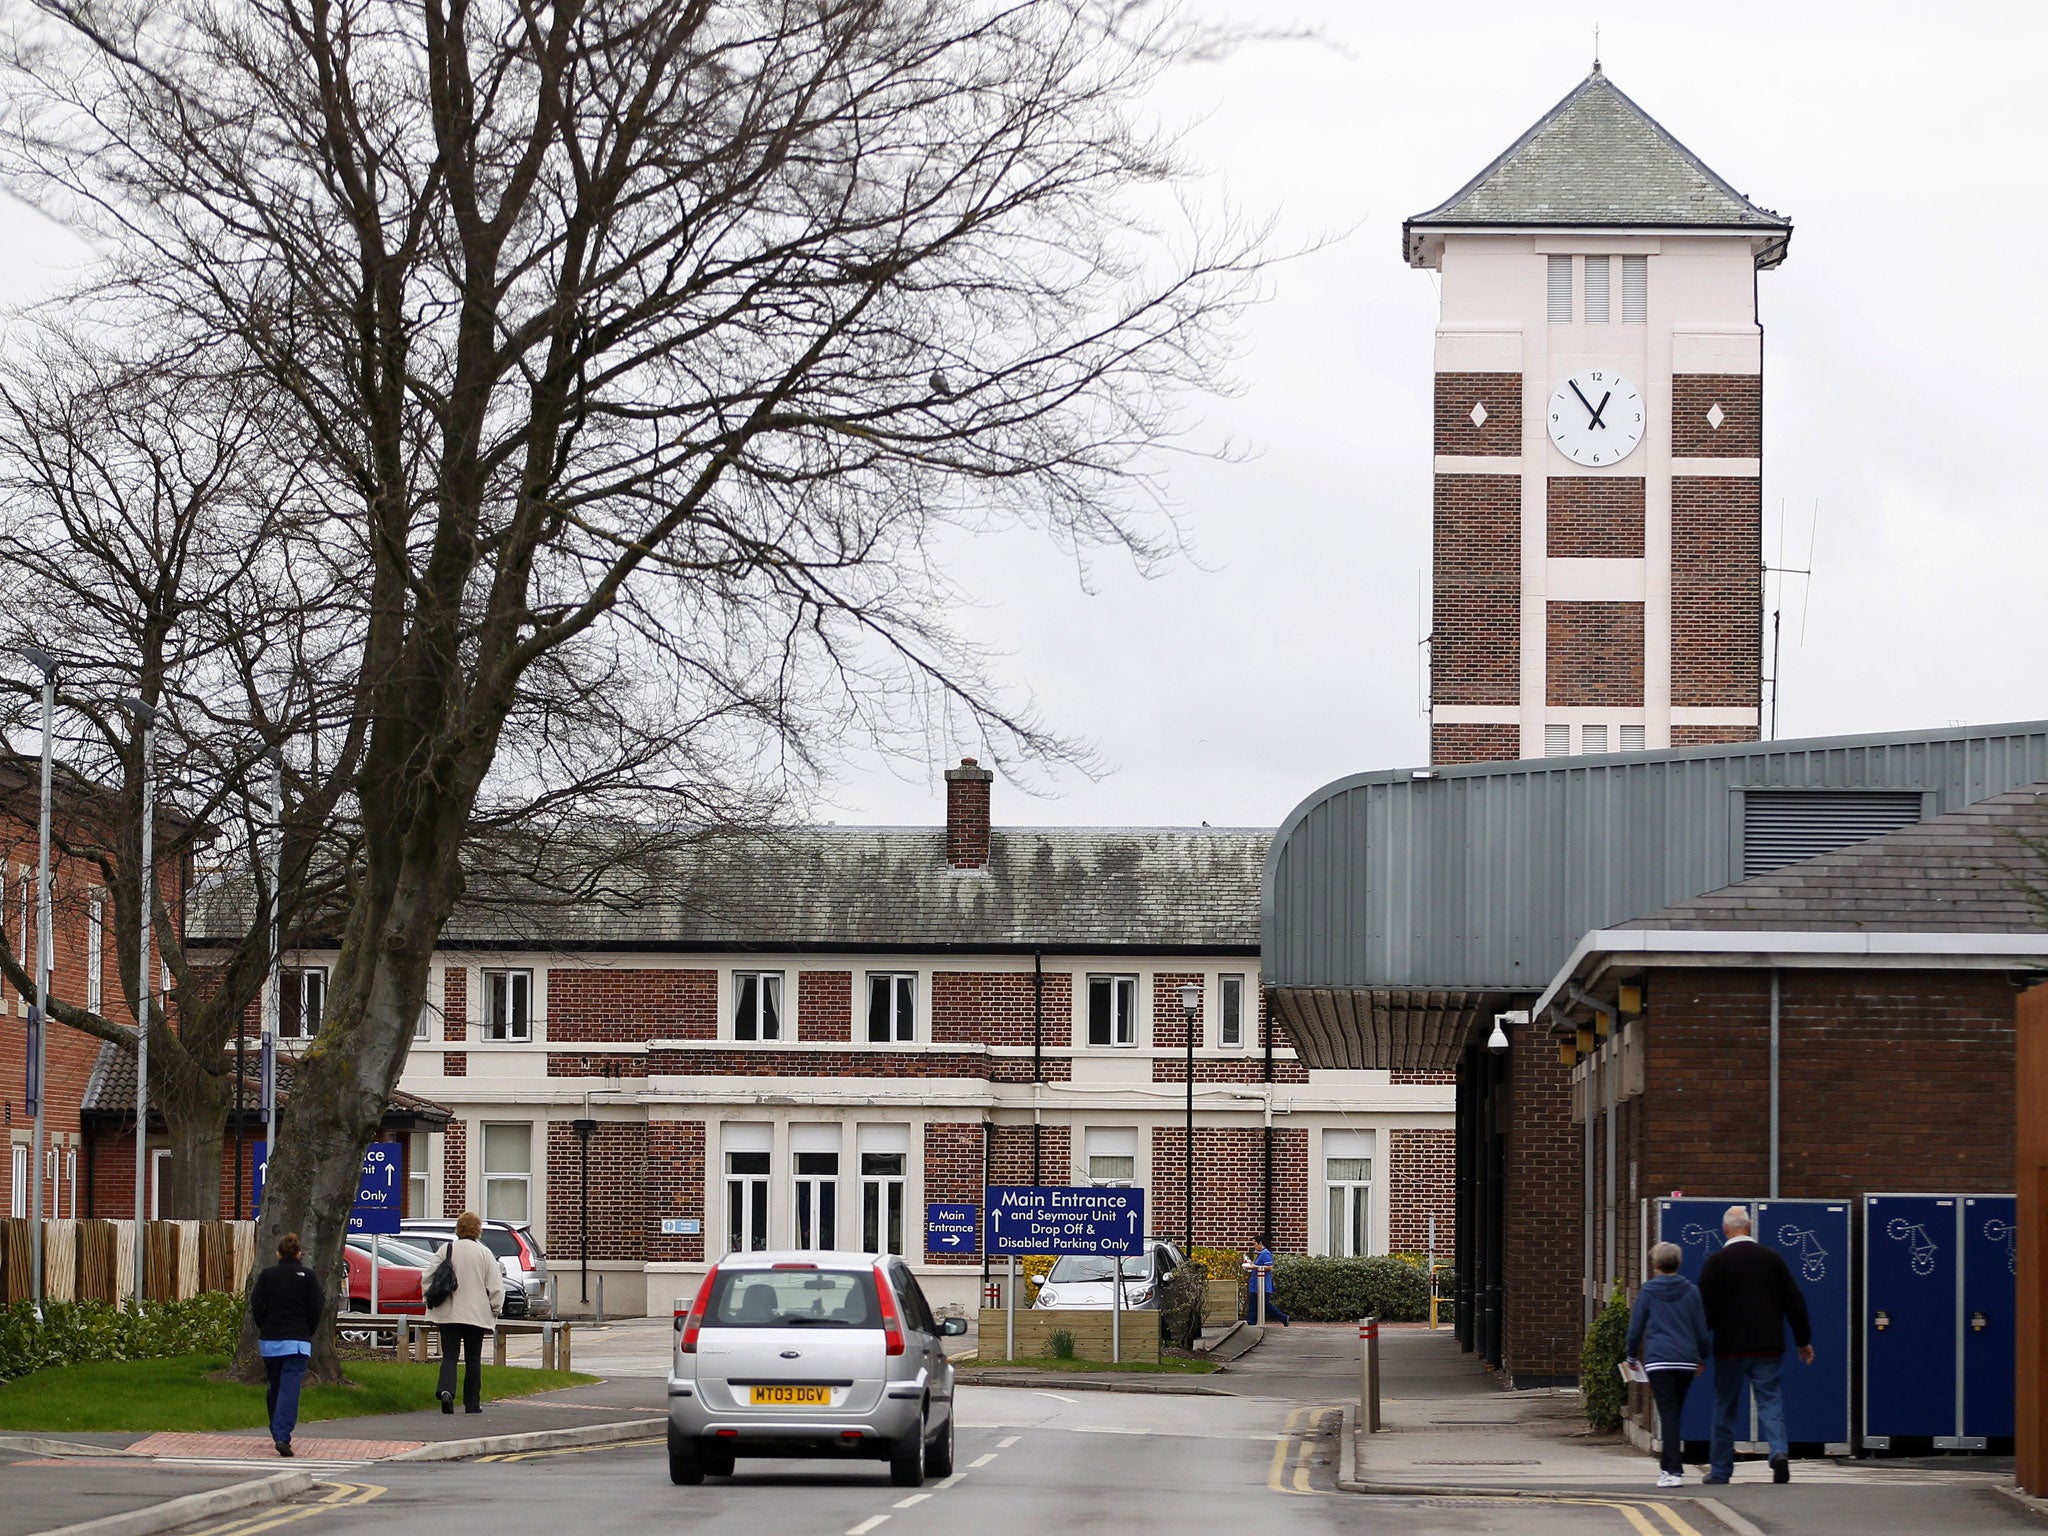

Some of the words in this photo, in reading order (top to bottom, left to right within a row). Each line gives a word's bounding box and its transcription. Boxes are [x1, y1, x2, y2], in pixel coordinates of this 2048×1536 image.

[1591, 372, 1603, 381] 12
[1552, 413, 1559, 422] 9
[1634, 413, 1641, 422] 3
[1593, 453, 1600, 462] 6
[362, 1164, 376, 1174] nit
[360, 1190, 387, 1203] Only
[1001, 1191, 1045, 1206] Main
[1052, 1191, 1127, 1208] Entrance
[939, 1210, 965, 1220] Main
[1011, 1210, 1034, 1220] and
[1037, 1209, 1088, 1223] Seymour
[1092, 1210, 1117, 1221] Unit
[929, 1222, 974, 1232] Entrance
[1031, 1224, 1061, 1236] Drop
[1064, 1223, 1084, 1234] Off
[1086, 1224, 1096, 1235] &
[999, 1237, 1049, 1248] Disabled
[1053, 1238, 1097, 1251] Parking
[1100, 1238, 1129, 1251] Only
[756, 1387, 792, 1401] MT03
[797, 1387, 825, 1401] DGV
